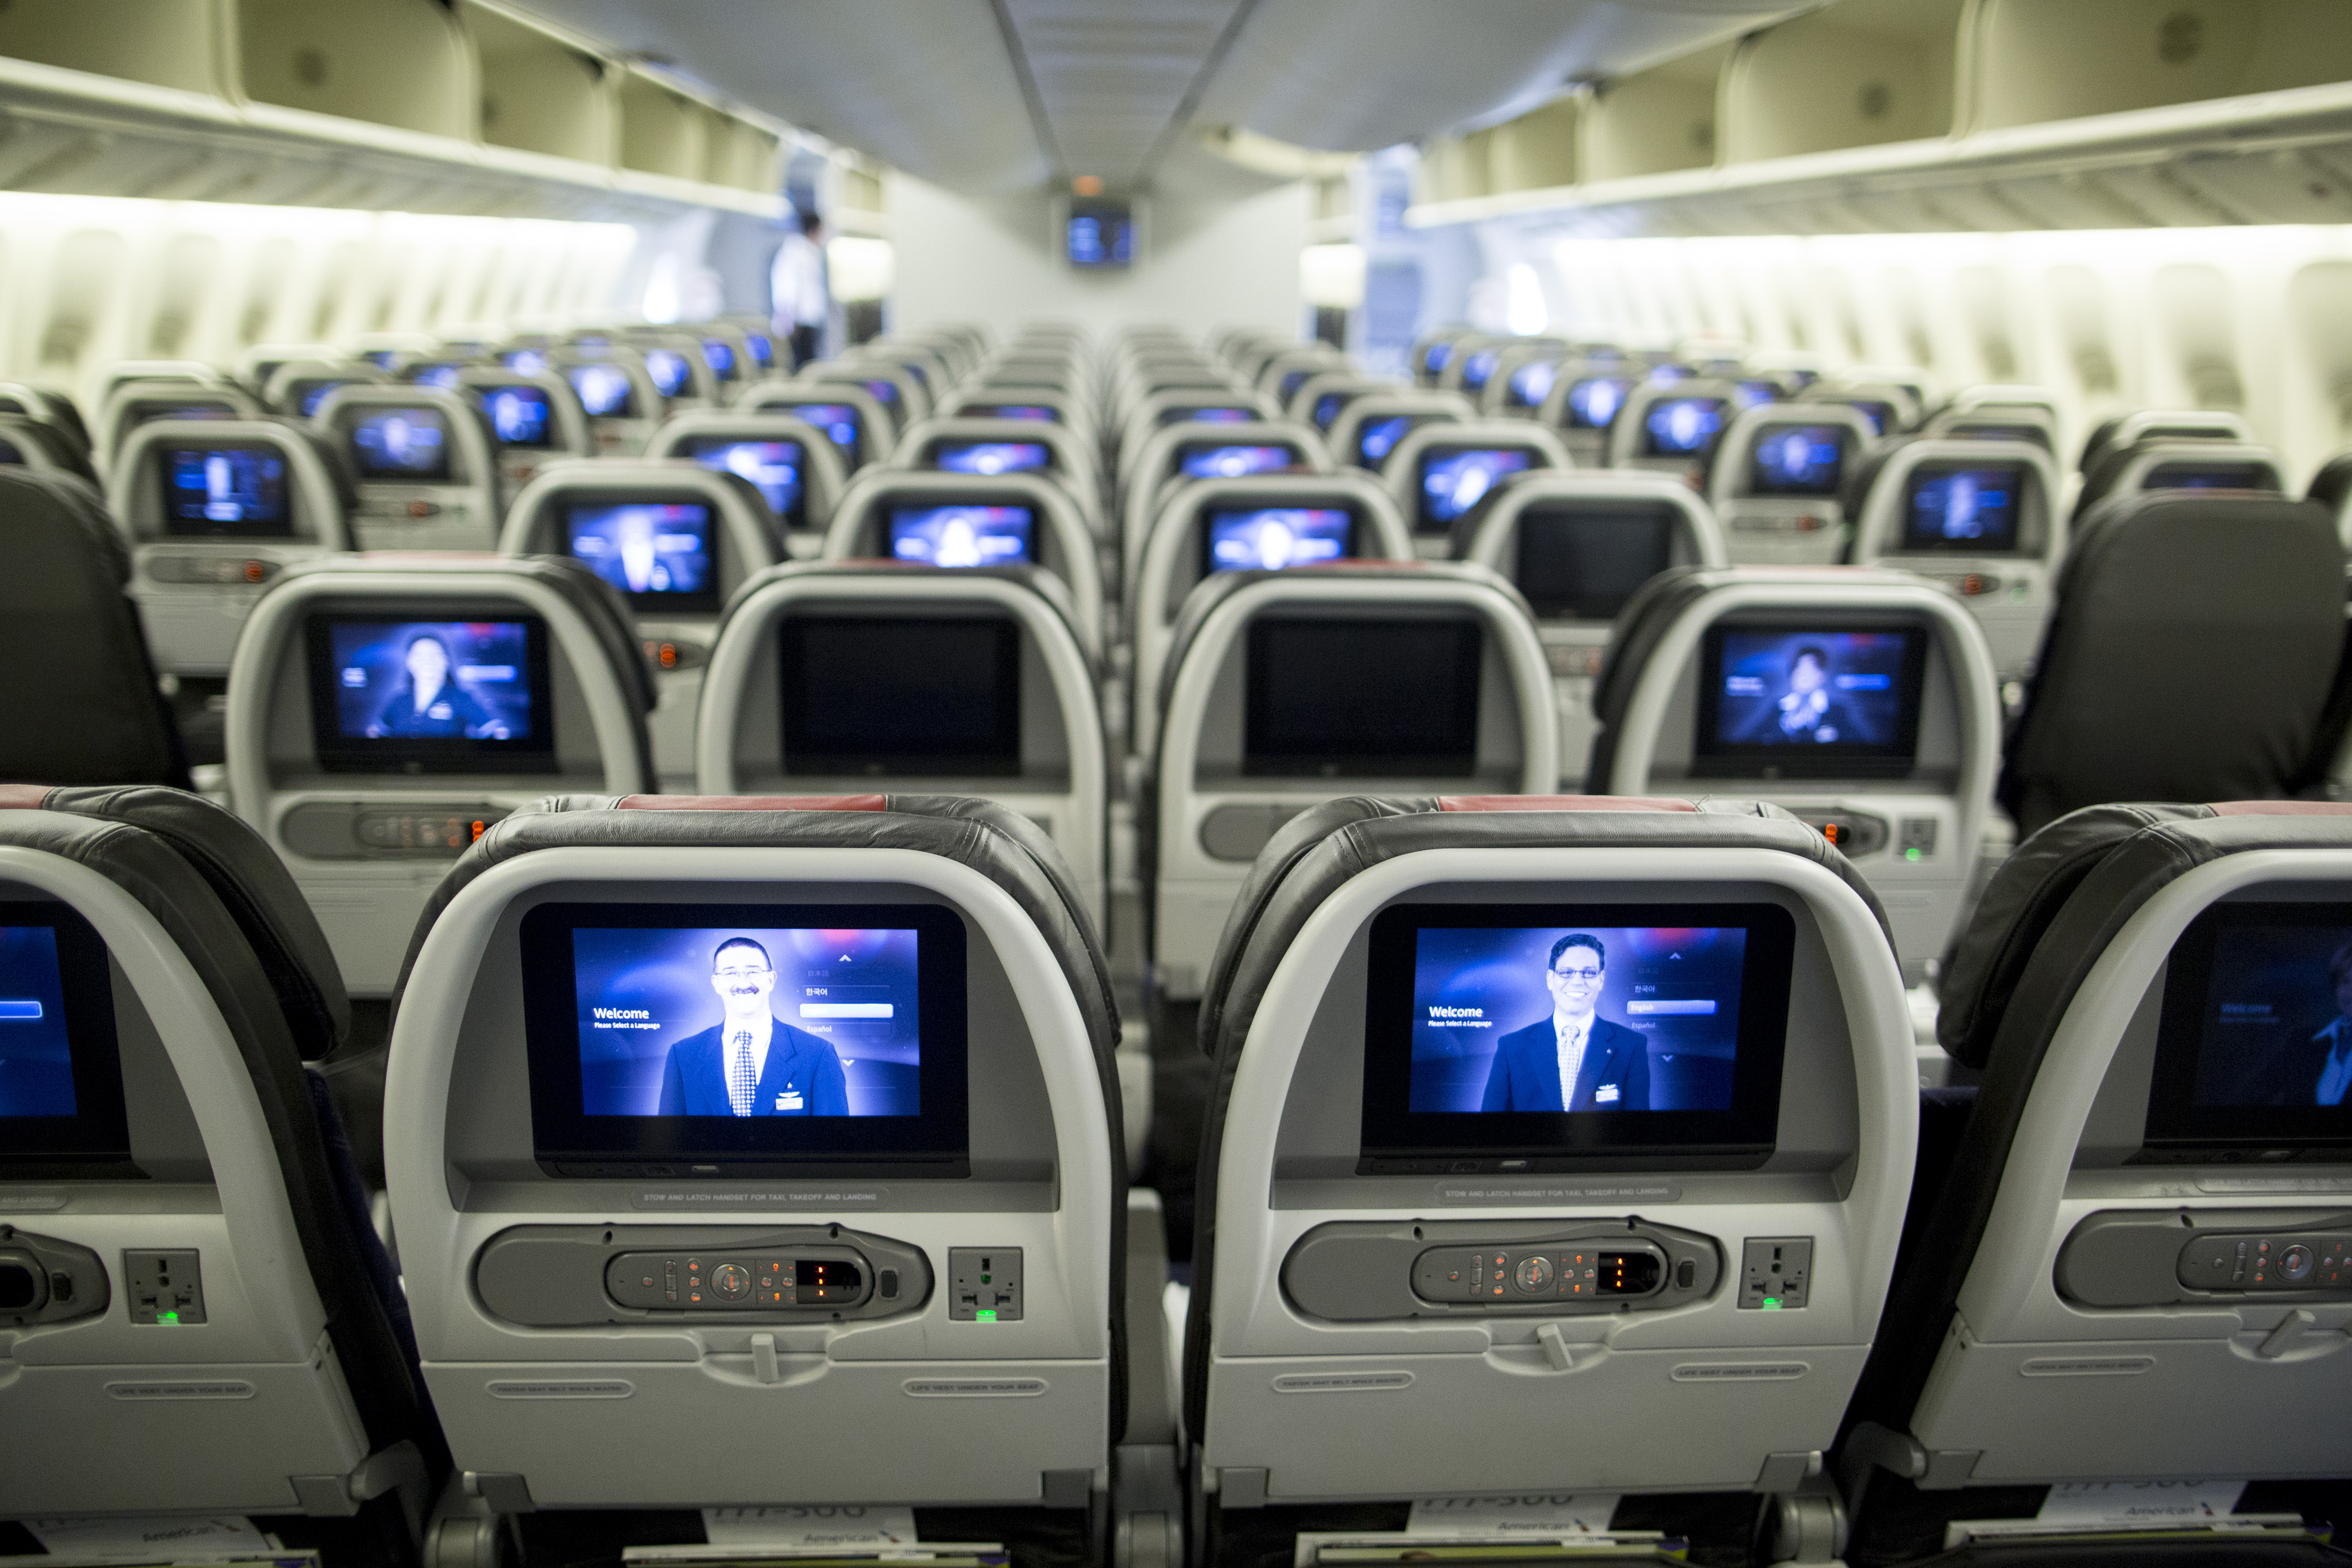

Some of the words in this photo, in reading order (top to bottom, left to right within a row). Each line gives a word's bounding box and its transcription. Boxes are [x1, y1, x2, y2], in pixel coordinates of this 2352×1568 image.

[806, 988, 827, 996] 한국어
[593, 1008, 649, 1019] Welcome
[1429, 1006, 1483, 1018] Welcome
